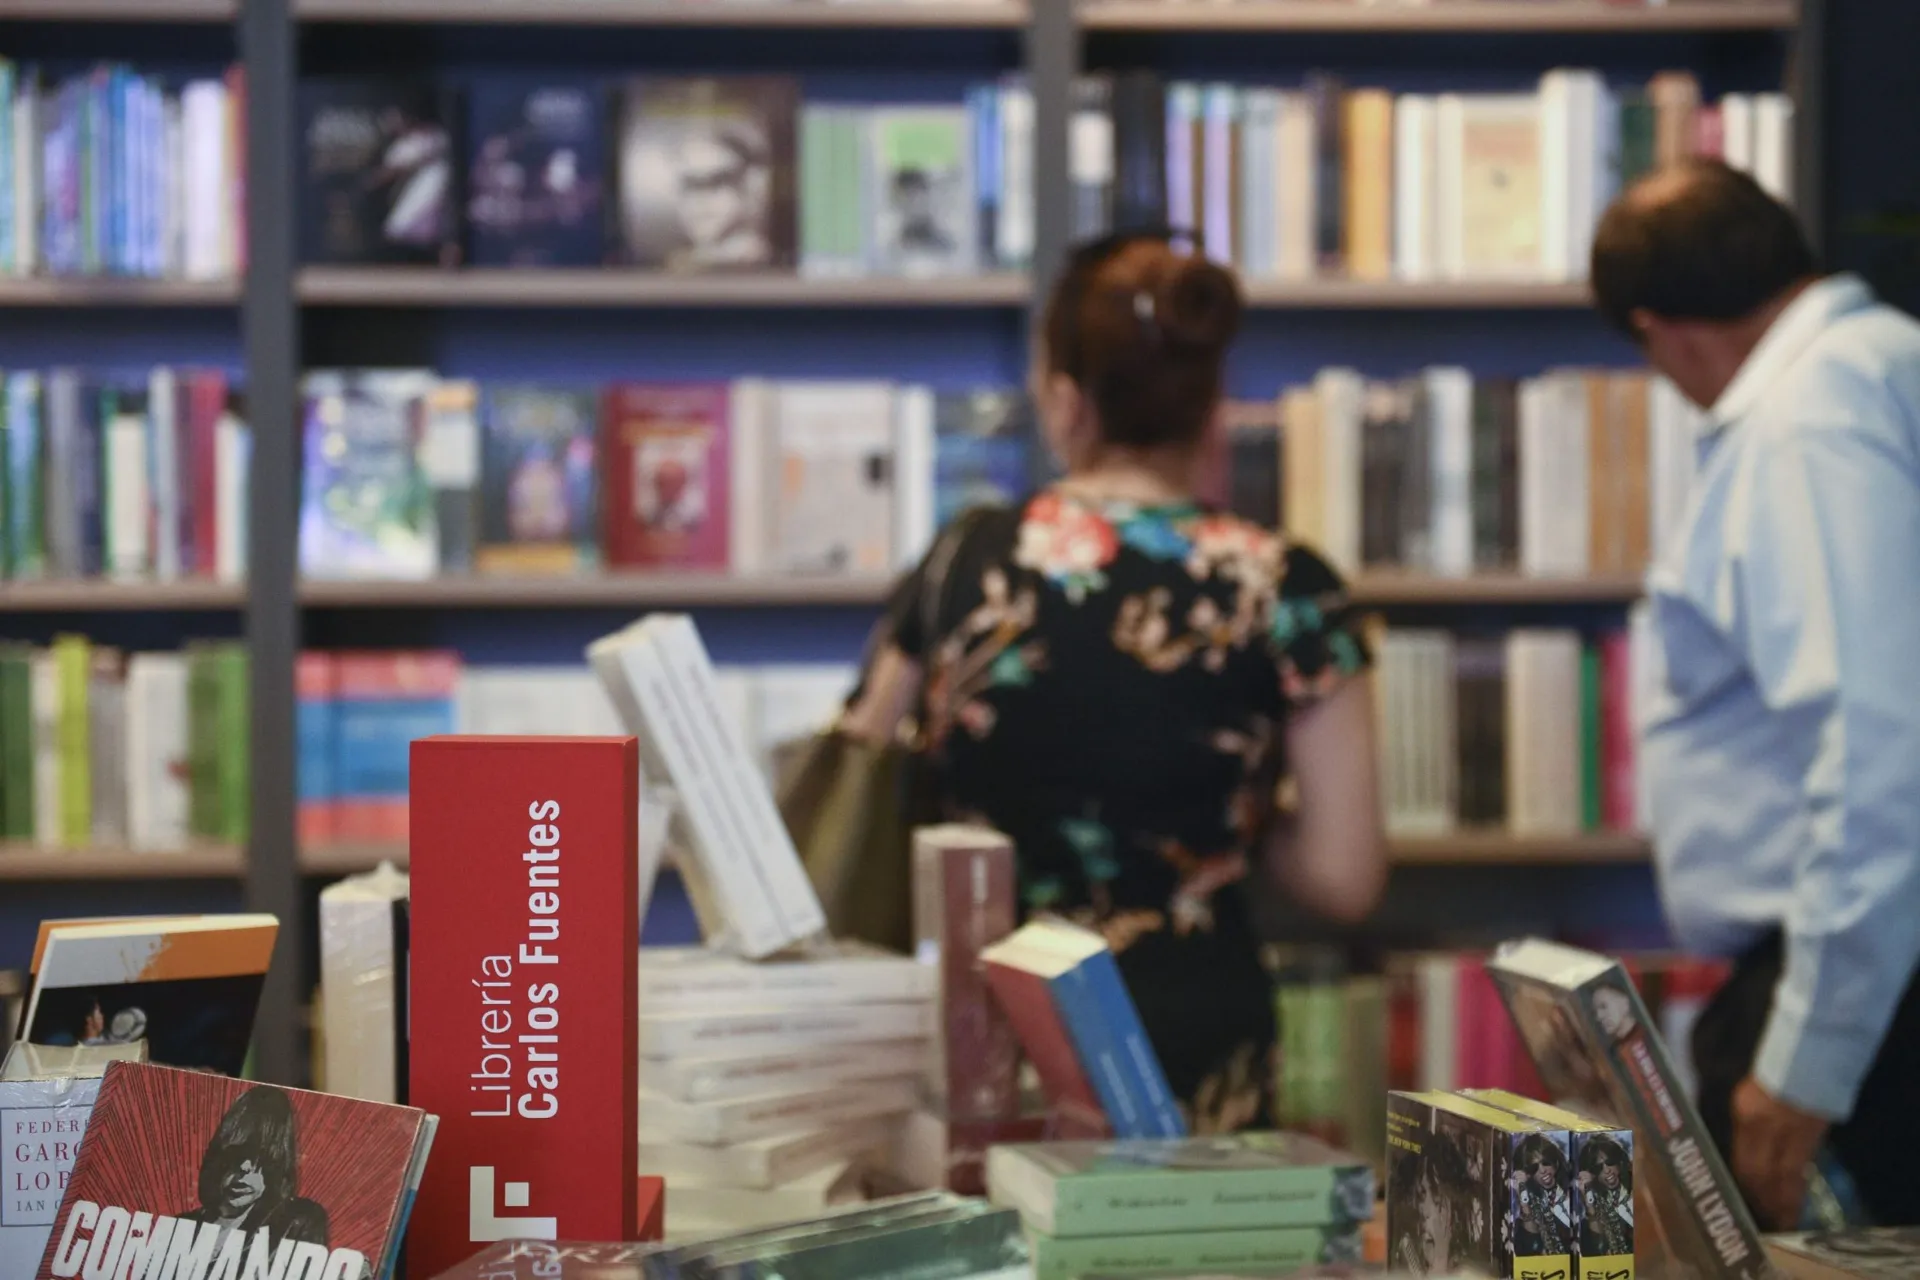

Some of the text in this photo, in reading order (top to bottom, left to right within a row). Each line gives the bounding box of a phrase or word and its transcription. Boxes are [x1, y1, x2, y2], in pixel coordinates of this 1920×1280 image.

[518, 799, 561, 1119] Carlos Fuentes
[470, 955, 512, 1118] Librería
[16, 1201, 45, 1211] IAN
[1668, 1136, 1750, 1267] JOHN LYDON
